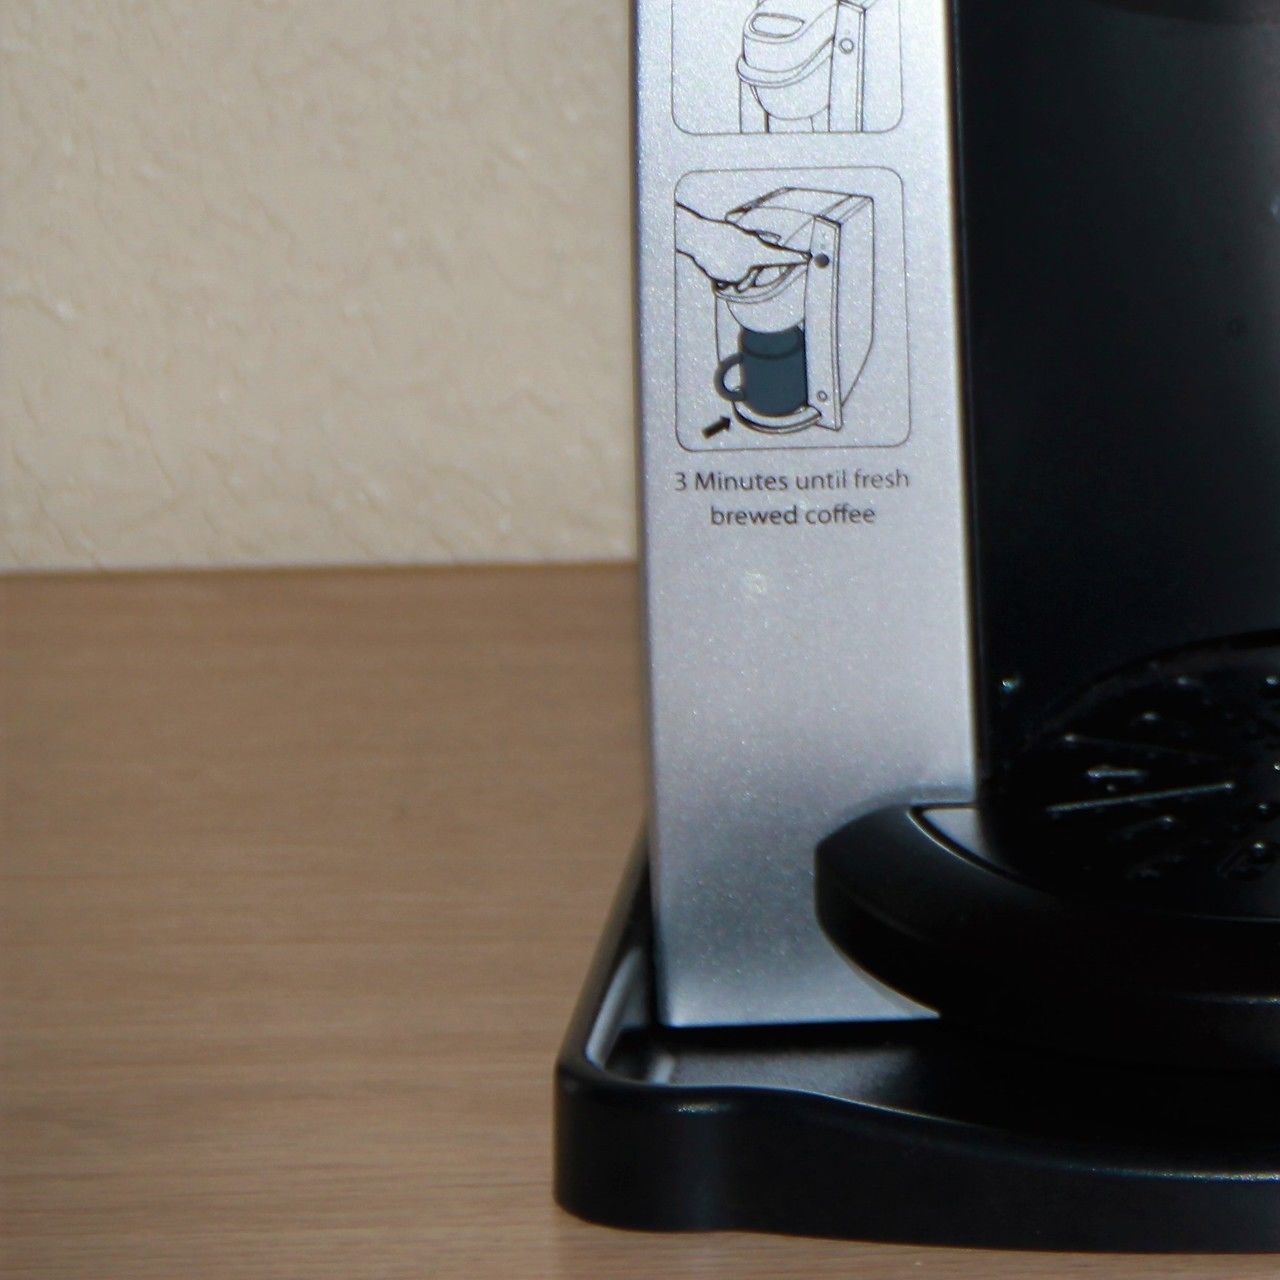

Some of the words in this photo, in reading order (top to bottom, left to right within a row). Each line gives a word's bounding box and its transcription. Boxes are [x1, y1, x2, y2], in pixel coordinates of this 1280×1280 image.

[674, 472, 687, 491] 3
[694, 471, 788, 491] Minutes
[796, 469, 847, 490] until
[855, 468, 910, 489] fresh
[711, 505, 798, 525] brewed
[805, 503, 876, 524] coffee
